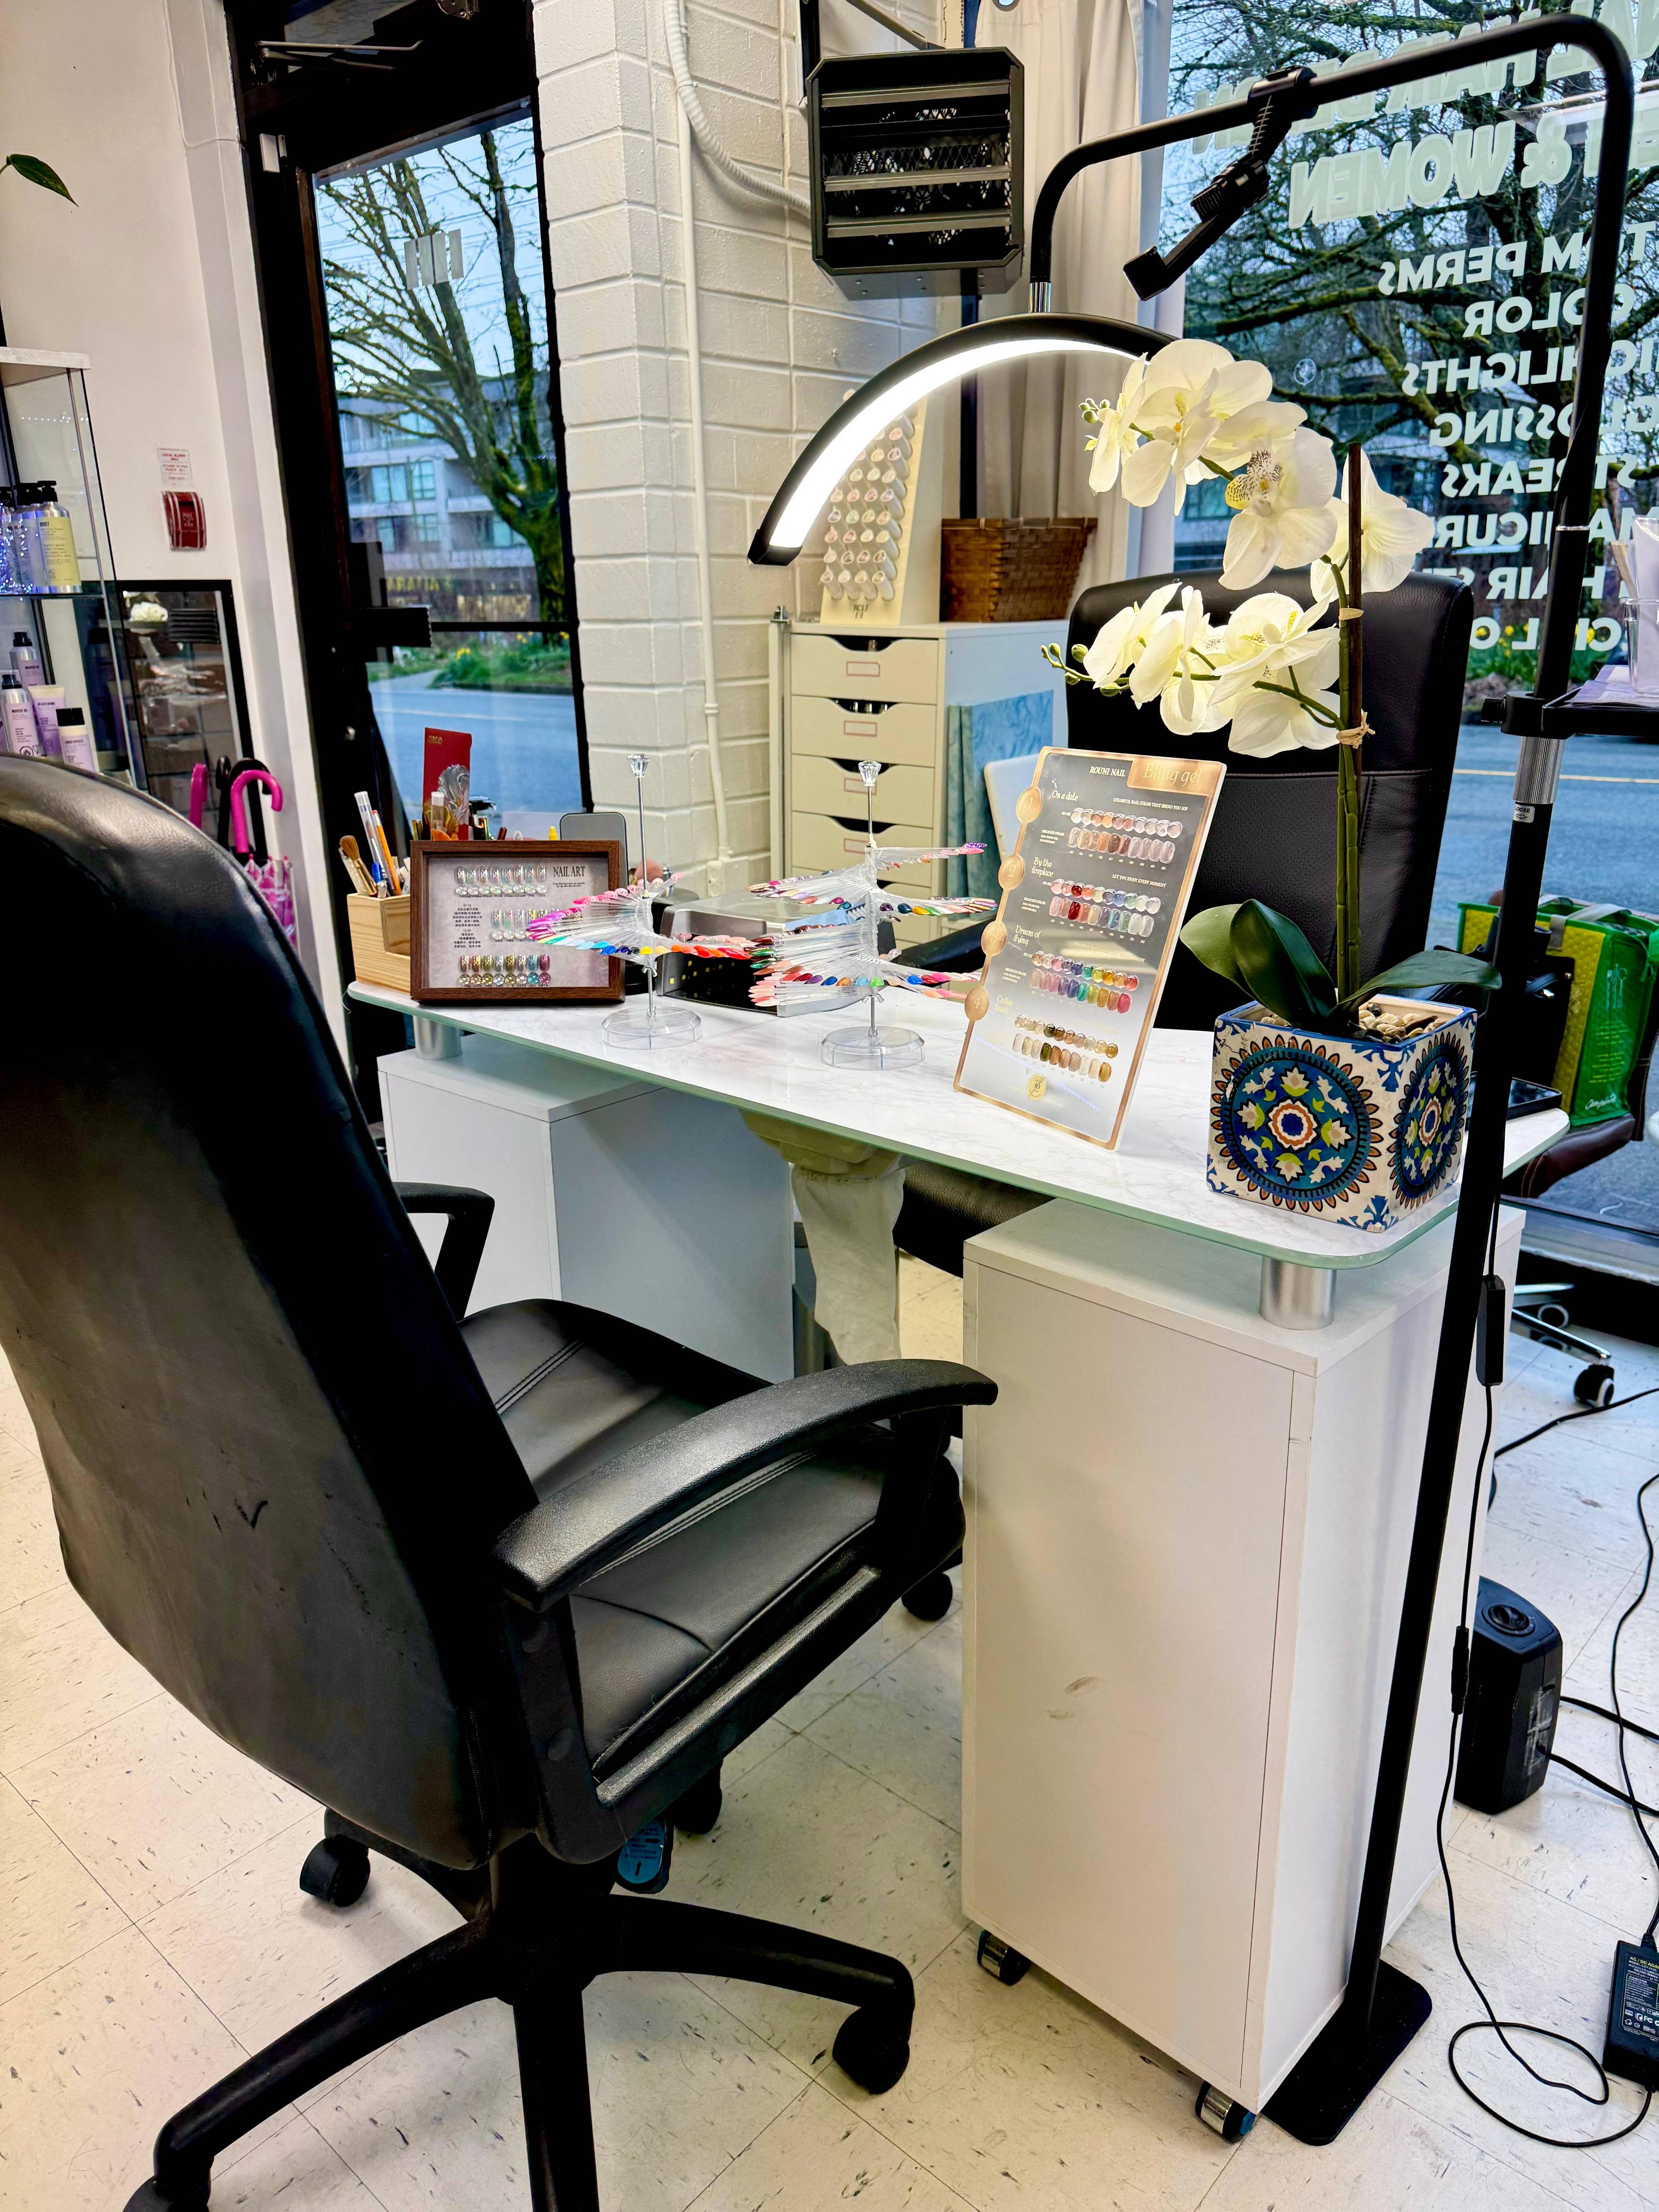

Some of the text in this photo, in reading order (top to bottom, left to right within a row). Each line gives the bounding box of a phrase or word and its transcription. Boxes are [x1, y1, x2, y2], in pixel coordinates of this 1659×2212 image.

[1090, 766, 1125, 777] ROUNI NAIL
[1143, 763, 1203, 787] Bling gel
[1052, 790, 1060, 799] On
[1066, 792, 1078, 801] date
[1033, 857, 1052, 868] By the
[553, 866, 585, 877] NAIL ART
[1031, 866, 1053, 877] fireplace
[1015, 925, 1041, 938] Dream of
[1013, 934, 1029, 947] flying
[973, 996, 981, 1009] 4
